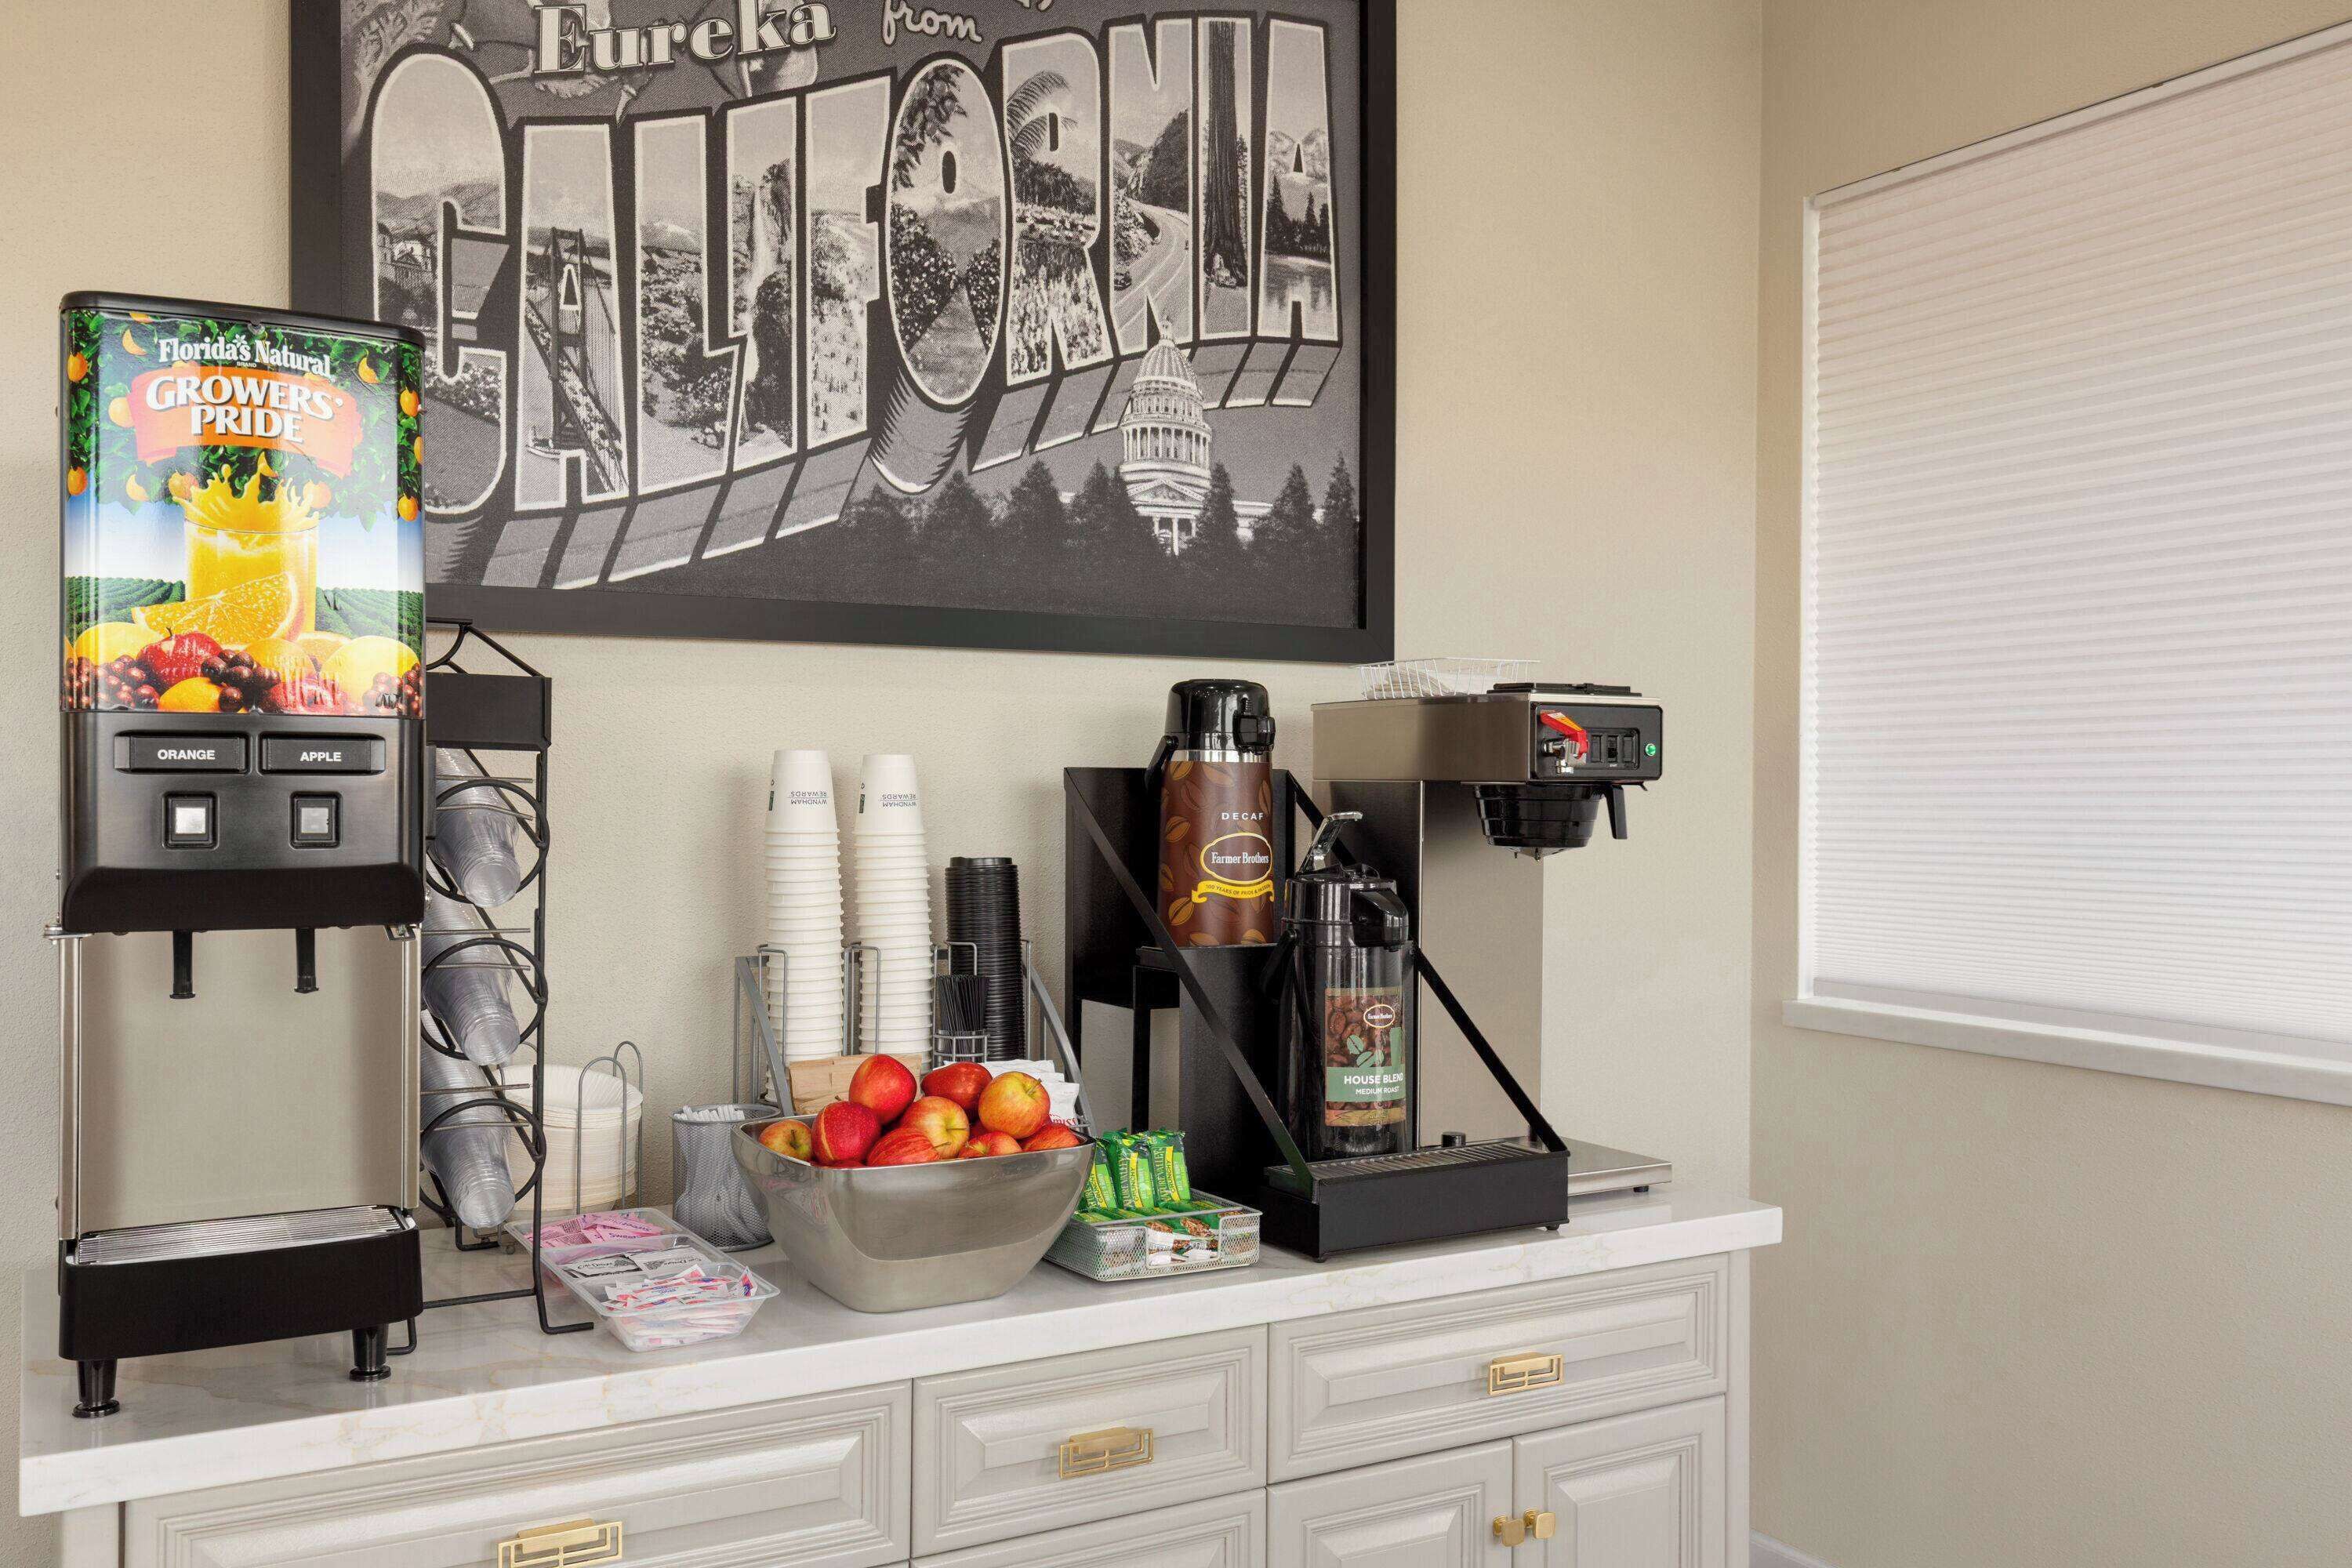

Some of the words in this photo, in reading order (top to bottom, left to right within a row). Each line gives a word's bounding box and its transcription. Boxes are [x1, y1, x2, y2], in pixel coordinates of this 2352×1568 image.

[535, 0, 837, 74] Eureka
[883, 0, 982, 45] from
[371, 16, 1342, 517] CALIFORNIA
[158, 336, 251, 363] Florida's
[254, 339, 332, 376] Natural
[191, 404, 305, 444] PRIDE
[157, 749, 216, 760] ORANGE
[299, 751, 342, 763] APPLE
[1211, 852, 1241, 864] Farmer
[1242, 851, 1269, 863] Brothers
[1216, 885, 1232, 895] YEARS
[1344, 1075, 1381, 1084] HOUSE
[1383, 1073, 1403, 1083] BLEND
[1166, 1160, 1176, 1193] CRUNCHY
